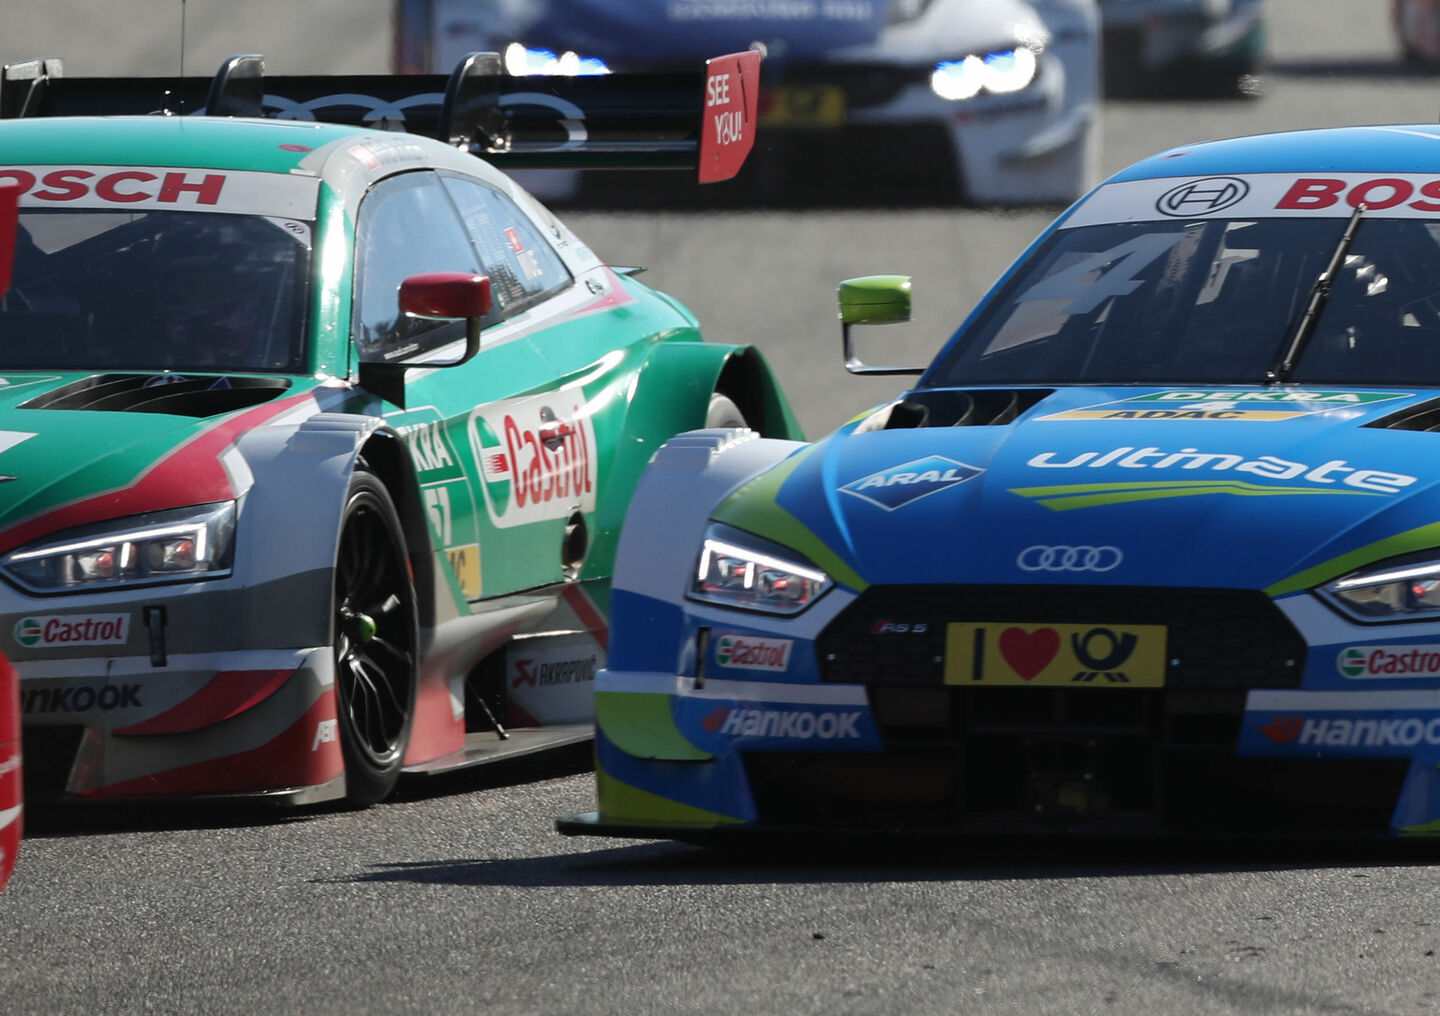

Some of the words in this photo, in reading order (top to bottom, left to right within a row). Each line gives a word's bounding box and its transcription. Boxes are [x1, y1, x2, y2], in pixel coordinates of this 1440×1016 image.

[707, 73, 731, 107] SEE
[1101, 410, 1246, 420] ADAC
[855, 466, 963, 490] ARAL
[1026, 446, 1419, 493] ultimate
[43, 617, 123, 643] Castrol
[731, 640, 786, 667] Castrol
